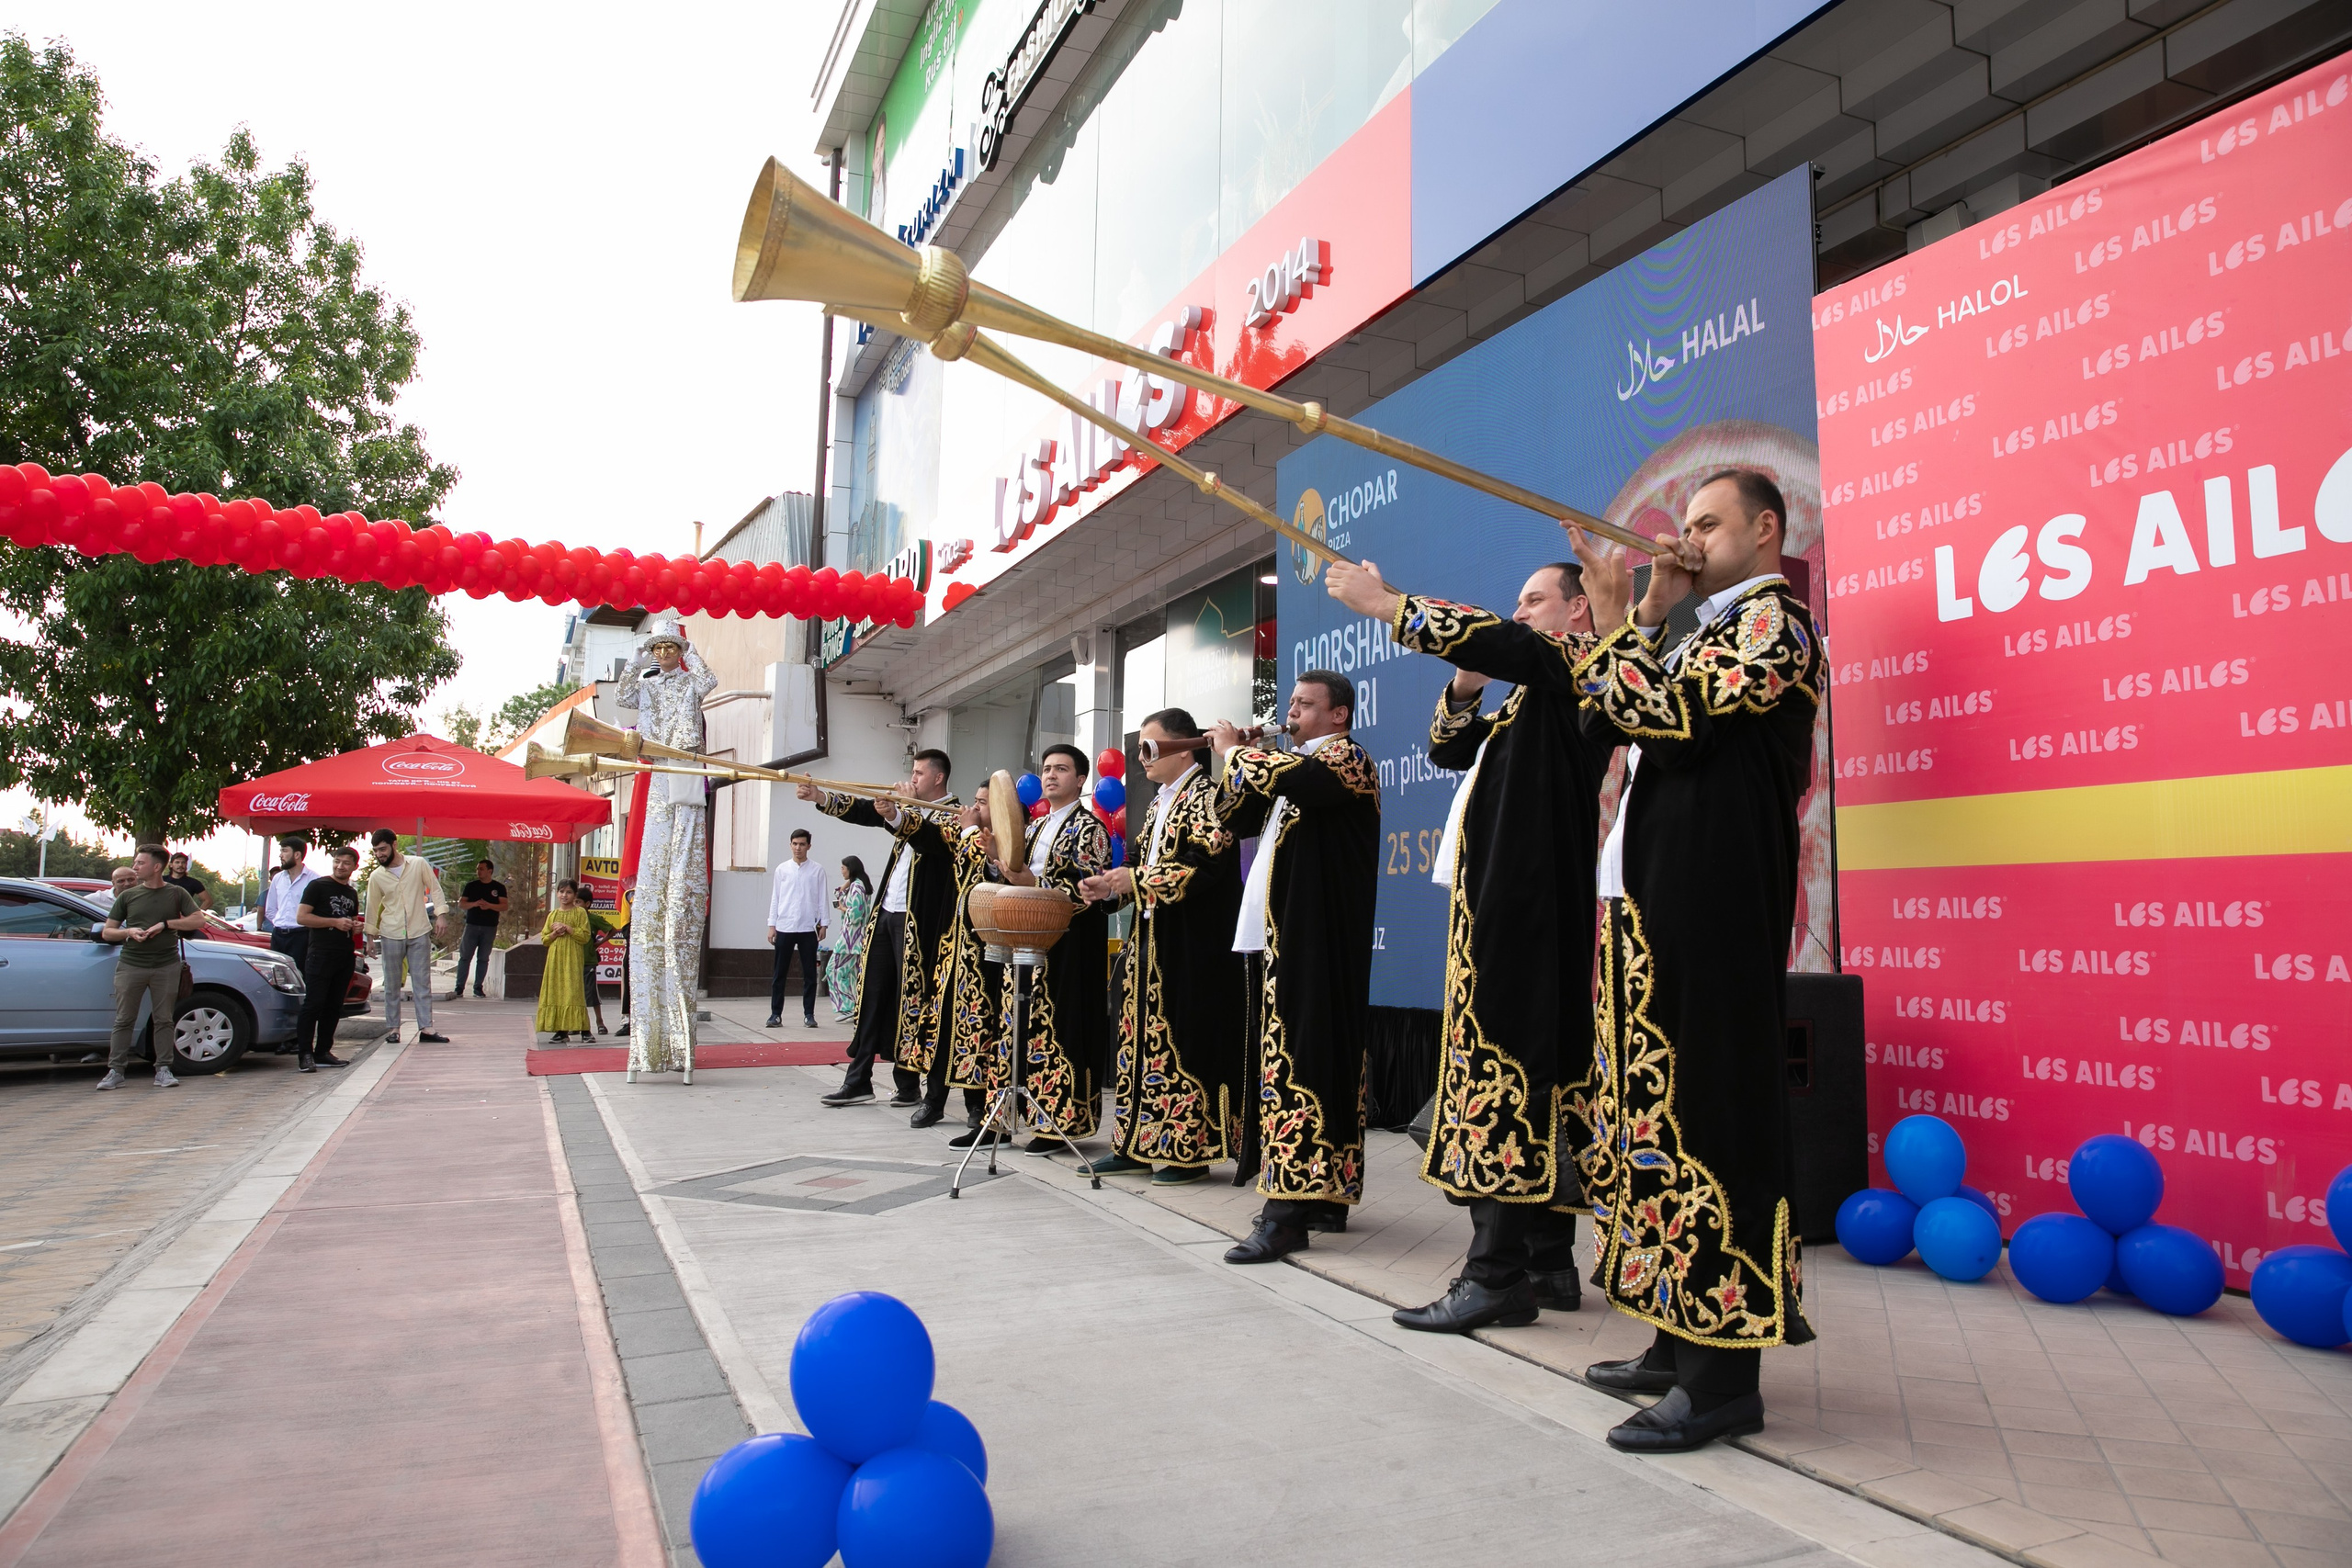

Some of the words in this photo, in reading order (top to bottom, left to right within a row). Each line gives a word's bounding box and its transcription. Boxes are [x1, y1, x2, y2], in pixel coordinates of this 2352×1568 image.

[920, 11, 944, 71] Ingliz
[1007, 0, 1071, 102] FASHIO
[924, 50, 942, 95] Rus
[2201, 119, 2259, 164] LES
[2267, 74, 2352, 136] AILE
[1980, 225, 2022, 261] LES
[2030, 189, 2103, 241] AILES
[2076, 237, 2123, 275] LES
[2132, 197, 2217, 253] AILES
[2210, 235, 2267, 277] LES
[1245, 237, 1317, 327] 2014
[1850, 276, 1907, 317] AILES
[1938, 275, 2029, 330] HALOL
[1682, 298, 1765, 365] HALAL
[1987, 325, 2029, 359] LES
[2037, 295, 2110, 342] AILES
[2084, 345, 2132, 380] LES
[2140, 312, 2225, 363] AILES
[2218, 353, 2275, 391] LES
[1818, 392, 1850, 420] LES
[1856, 369, 1913, 407] AILES
[1872, 419, 1907, 447] LES
[1915, 395, 1976, 434] AILES
[1994, 427, 2036, 459] LES
[2043, 401, 2119, 445] AILES
[2091, 455, 2139, 488] LES
[2147, 428, 2233, 474] AILES
[1328, 469, 1398, 530] CHOPAR
[1822, 483, 1855, 511] LES
[1861, 464, 1919, 499] AILES
[1878, 513, 1914, 541] LES
[1920, 494, 1983, 530] AILES
[1329, 531, 1351, 551] PIZZA
[1827, 575, 1860, 600] LES
[1866, 559, 1924, 592] AILES
[1934, 513, 2093, 623] LES
[2233, 585, 2291, 619] LES
[821, 629, 843, 669] PONG
[1295, 617, 1413, 685] CHORSHAN
[2006, 630, 2049, 658] LES
[2056, 615, 2132, 649] AILES
[1871, 651, 1929, 681] AILES
[2104, 673, 2154, 703] LES
[2162, 660, 2250, 695] AILES
[1887, 702, 1923, 726] LES
[1929, 691, 1994, 720] AILES
[2241, 707, 2300, 738] LES
[1874, 750, 1934, 775] AILES
[2010, 736, 2054, 761] LES
[2062, 726, 2139, 757] AILES
[389, 761, 458, 772] Coca-Cola
[249, 793, 312, 812] Coca-Cola
[585, 860, 619, 874] AVTO
[1387, 832, 1410, 875] 25
[1894, 898, 1931, 919] LES
[1938, 897, 2003, 919] AILES
[2116, 903, 2165, 928] LES
[2175, 902, 2265, 929] AILES
[1841, 947, 1875, 968] LES
[1881, 948, 1941, 970] AILES
[2019, 950, 2064, 974] LES
[2072, 951, 2151, 976] AILES
[2255, 954, 2315, 982] LES
[1897, 997, 1935, 1020] LES
[1940, 999, 2007, 1024] AILES
[2120, 1017, 2172, 1044] LES
[2180, 1021, 2272, 1052] AILES
[1883, 1044, 1945, 1070] AILES
[2024, 1056, 2069, 1083] LES
[2076, 1061, 2156, 1091] AILES
[1898, 1087, 1937, 1112] LES
[1944, 1093, 2010, 1122] AILES
[2262, 1077, 2324, 1109] LES
[2185, 1130, 2278, 1166] AILES
